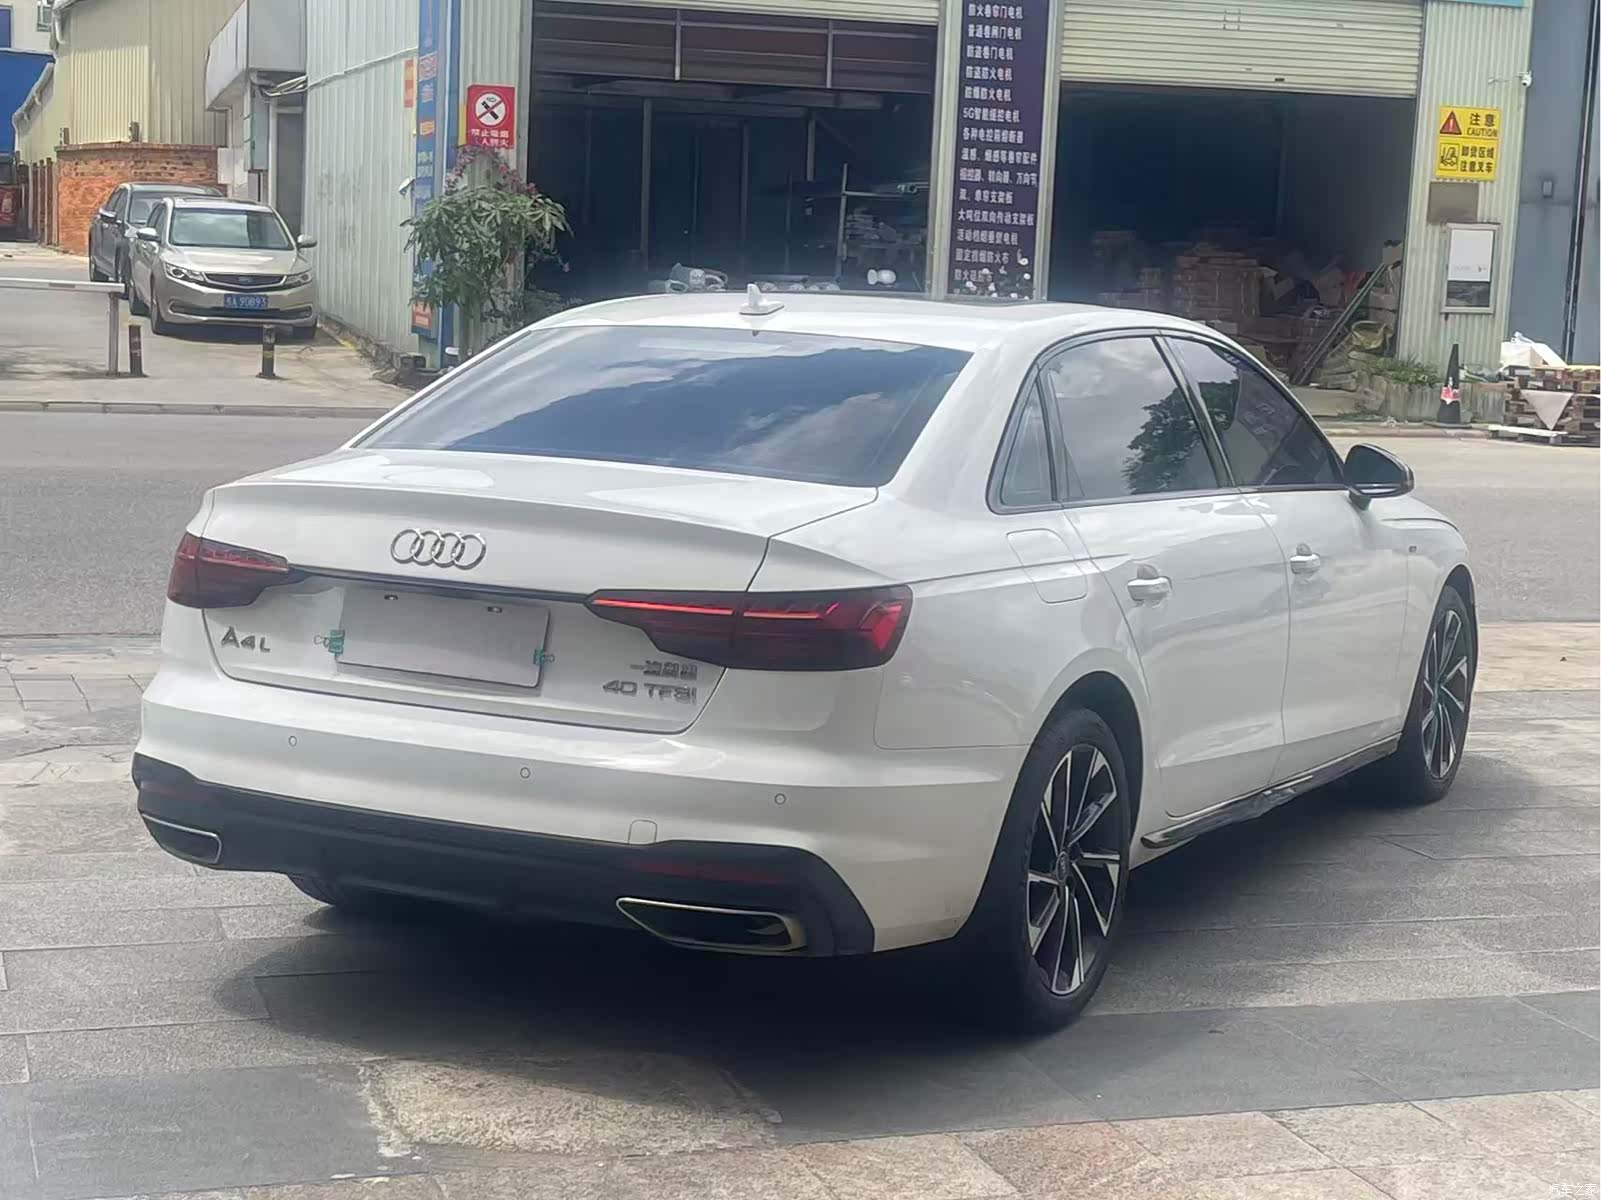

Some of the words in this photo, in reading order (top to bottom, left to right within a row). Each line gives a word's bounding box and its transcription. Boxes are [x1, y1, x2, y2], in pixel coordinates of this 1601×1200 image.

[1470, 112, 1495, 127] 注意
[1466, 127, 1498, 137] CAUTION
[1461, 145, 1495, 159] 卸货区域
[1460, 160, 1493, 173] 注意叉车
[221, 626, 271, 653] A4L
[602, 680, 638, 697] 40
[643, 682, 698, 704] TFSI
